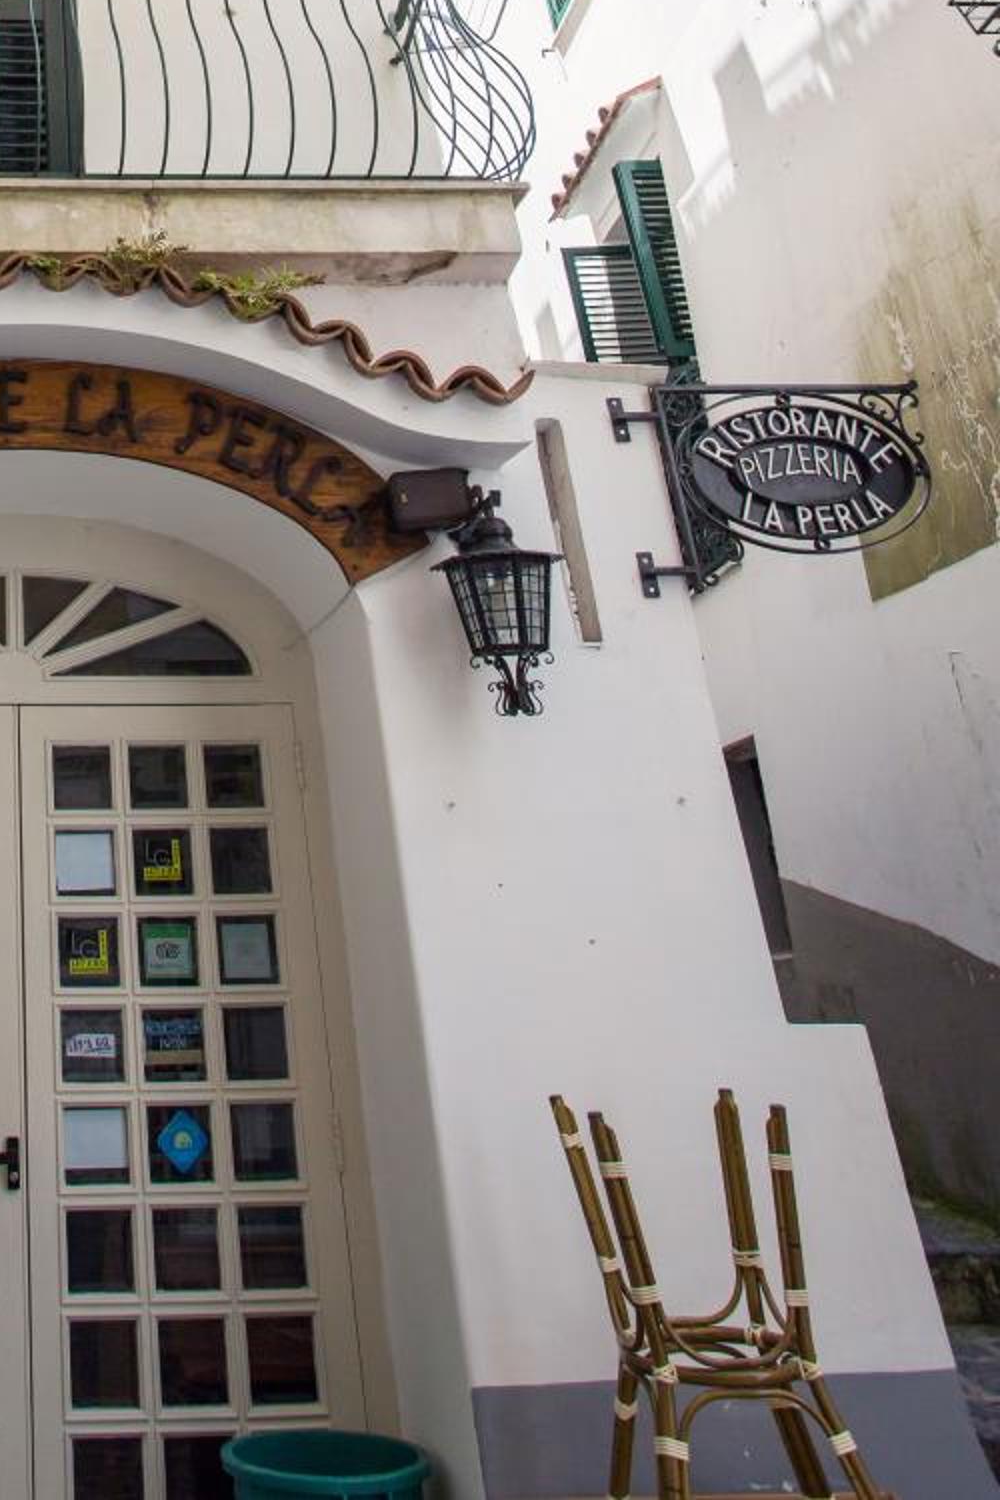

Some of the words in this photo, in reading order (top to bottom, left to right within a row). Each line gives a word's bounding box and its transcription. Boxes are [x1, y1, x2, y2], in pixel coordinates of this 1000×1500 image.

[63, 372, 139, 443] LA
[174, 390, 393, 549] PERLA
[699, 409, 903, 474] RISTORANTE
[740, 444, 862, 489] PIZZERIA
[743, 491, 784, 532] LA
[798, 489, 895, 535] PERLA
